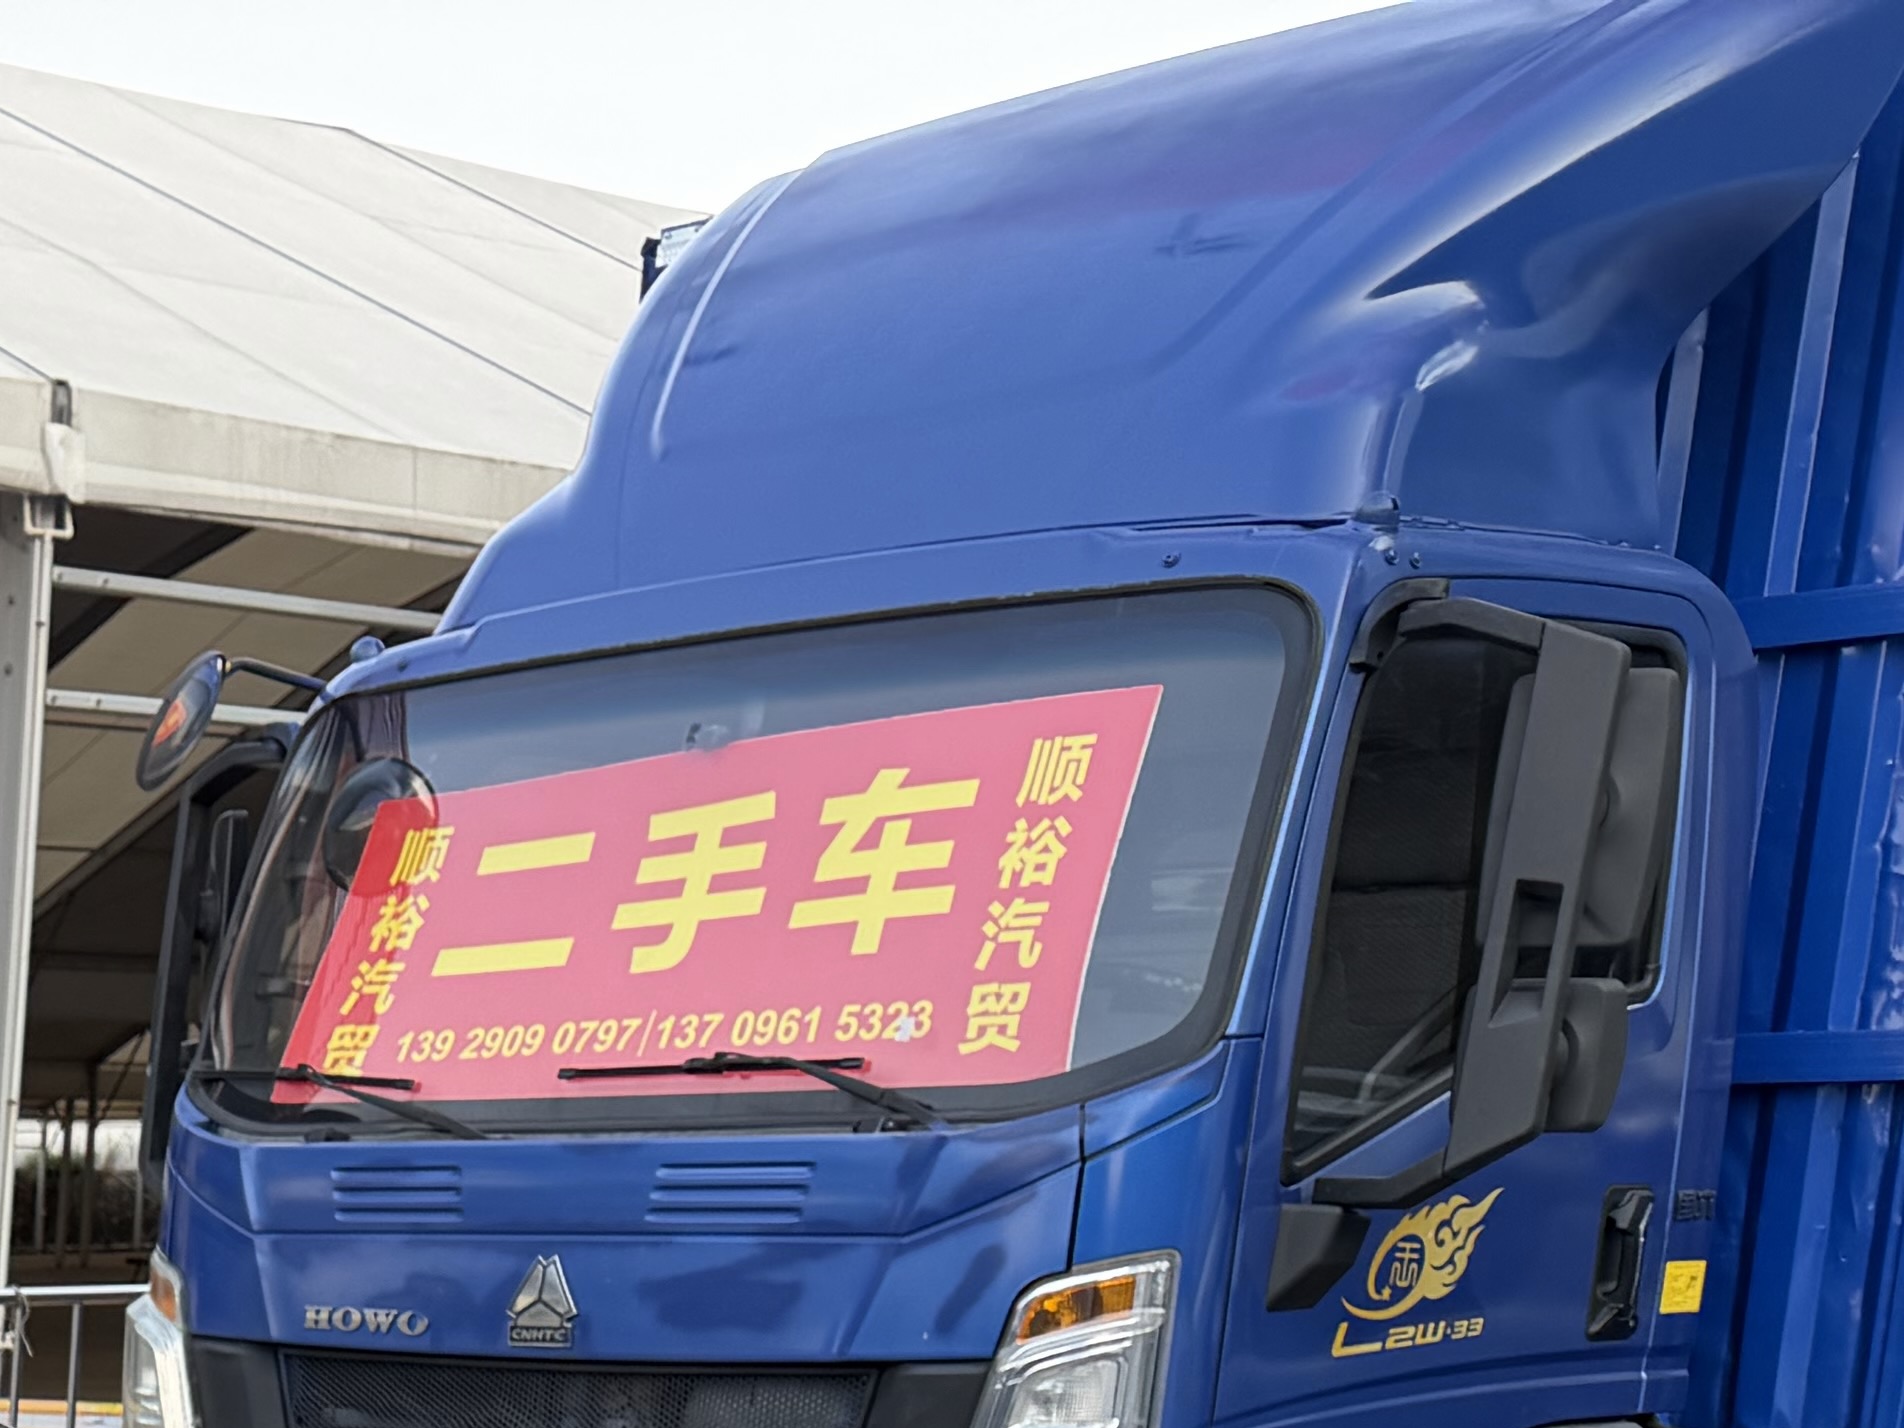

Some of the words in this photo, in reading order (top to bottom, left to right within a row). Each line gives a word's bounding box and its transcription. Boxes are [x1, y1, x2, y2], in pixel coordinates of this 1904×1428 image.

[431, 769, 980, 977] 二手车
[956, 733, 1098, 1057] 顺裕汽贸
[323, 826, 455, 1076] 顺裕汽贸
[396, 1029, 451, 1063] 139
[459, 1023, 545, 1060] 2909
[731, 1007, 822, 1045] 0961
[834, 999, 934, 1042] 5323
[303, 1304, 430, 1337] HOWO
[510, 1327, 568, 1343] CNHTC
